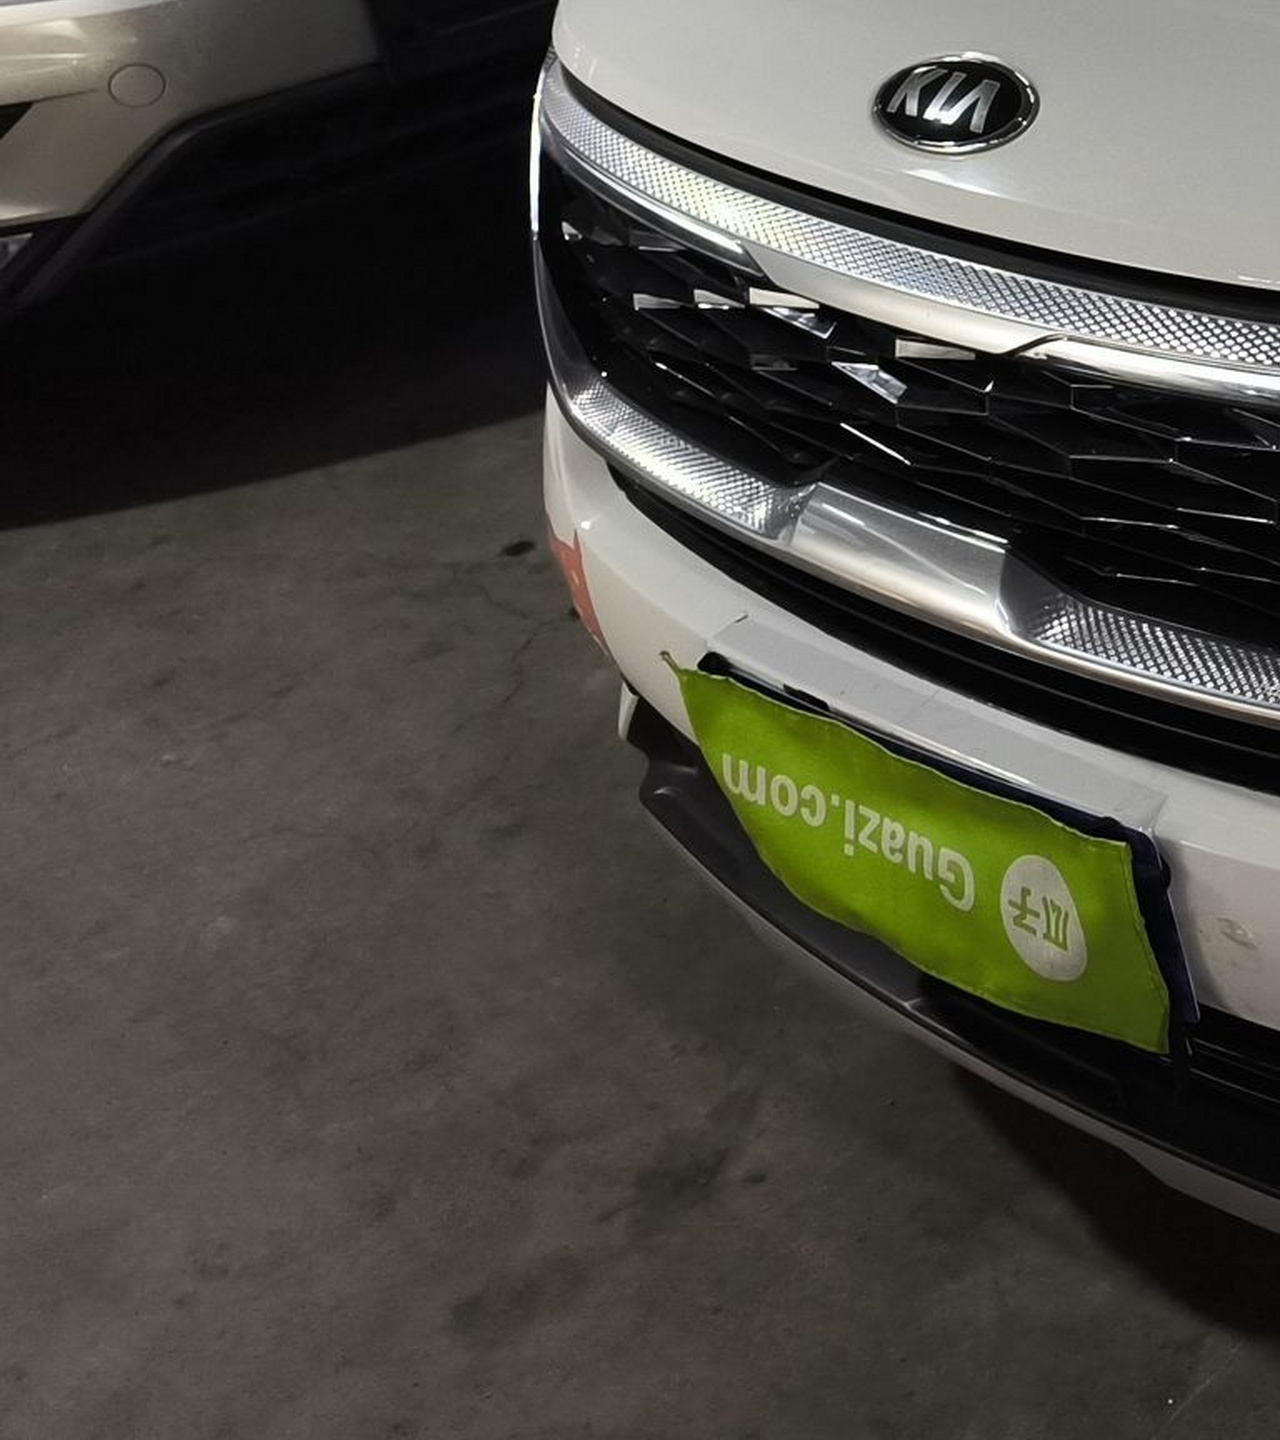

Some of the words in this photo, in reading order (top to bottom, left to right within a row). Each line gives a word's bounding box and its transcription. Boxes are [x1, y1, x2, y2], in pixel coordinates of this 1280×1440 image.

[886, 68, 1001, 134] KIA
[722, 753, 977, 912] Guazi.com
[1008, 886, 1071, 953] 瓜子
